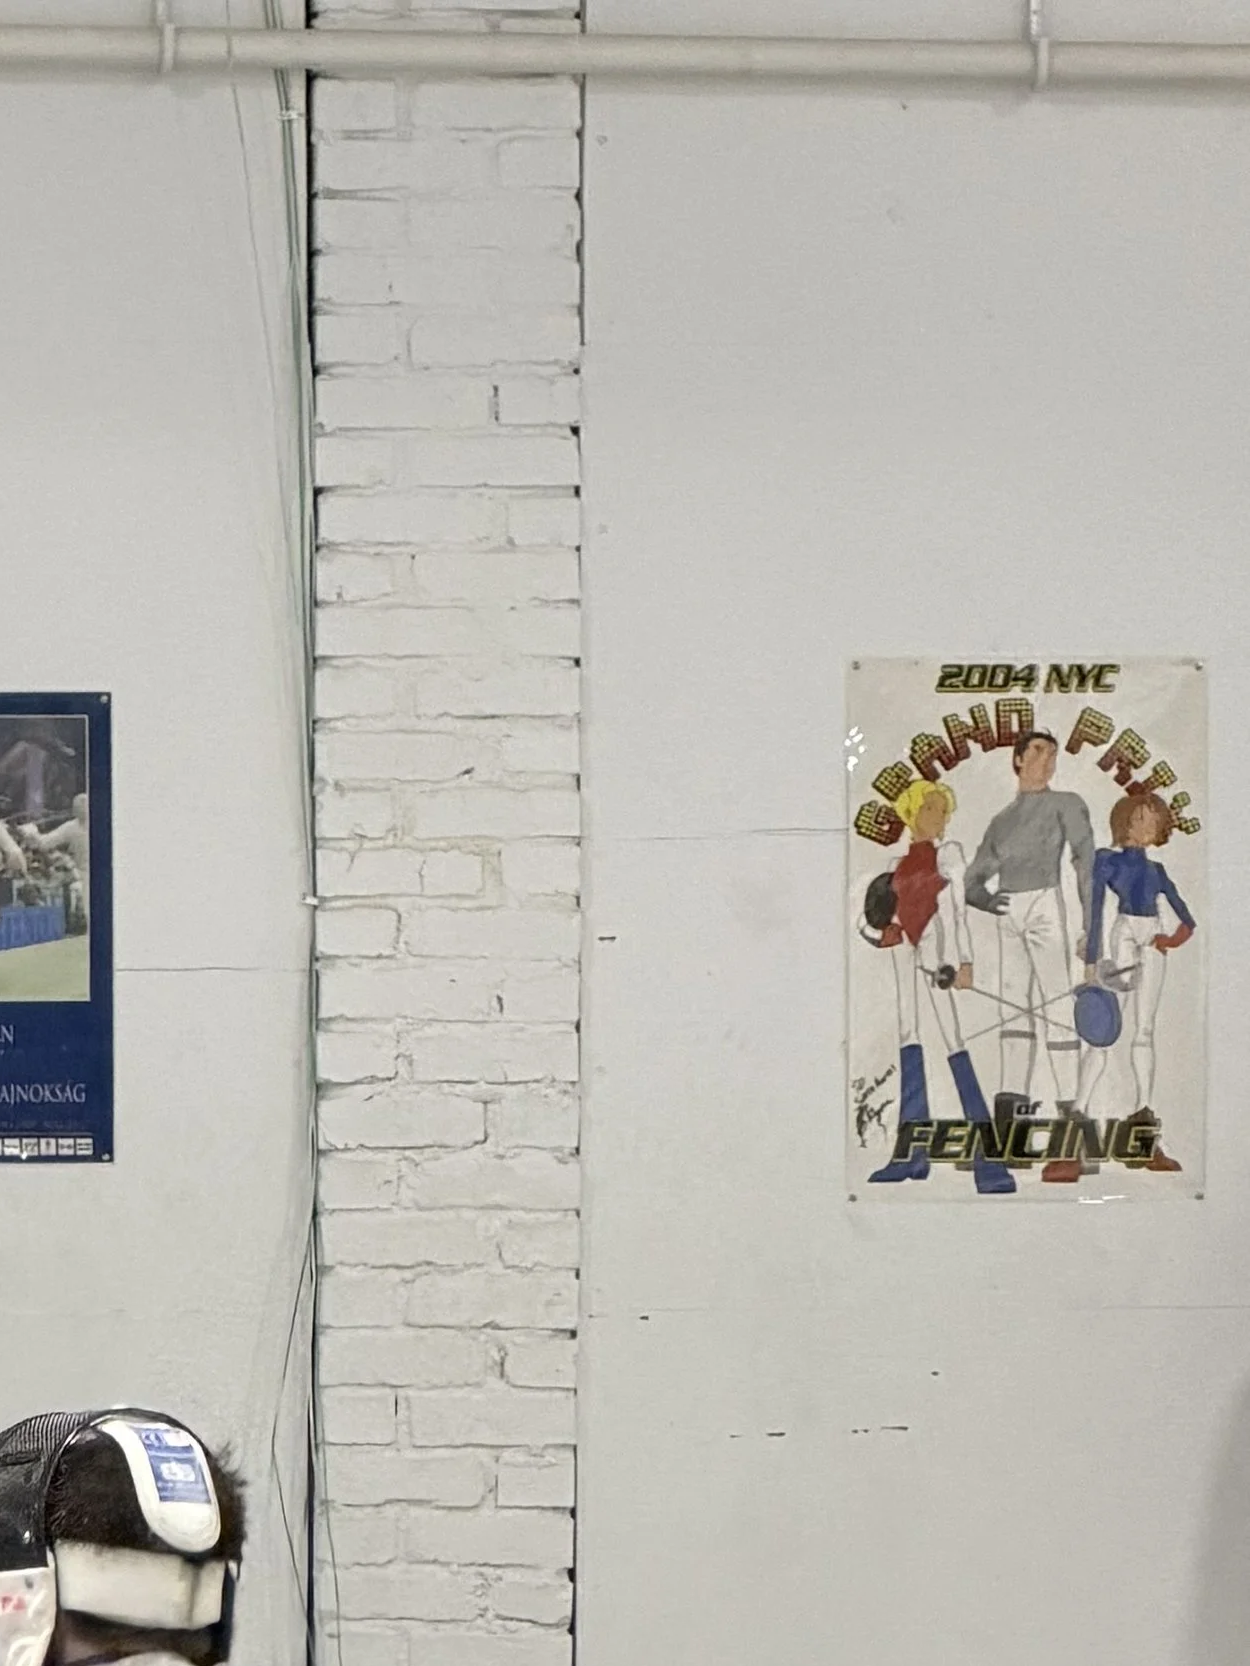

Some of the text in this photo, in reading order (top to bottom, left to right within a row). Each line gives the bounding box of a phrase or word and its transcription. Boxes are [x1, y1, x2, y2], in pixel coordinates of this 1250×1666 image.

[935, 663, 1121, 693] 2004 NYC
[854, 697, 1035, 847] GRAND
[891, 1118, 1161, 1163] FENCING
